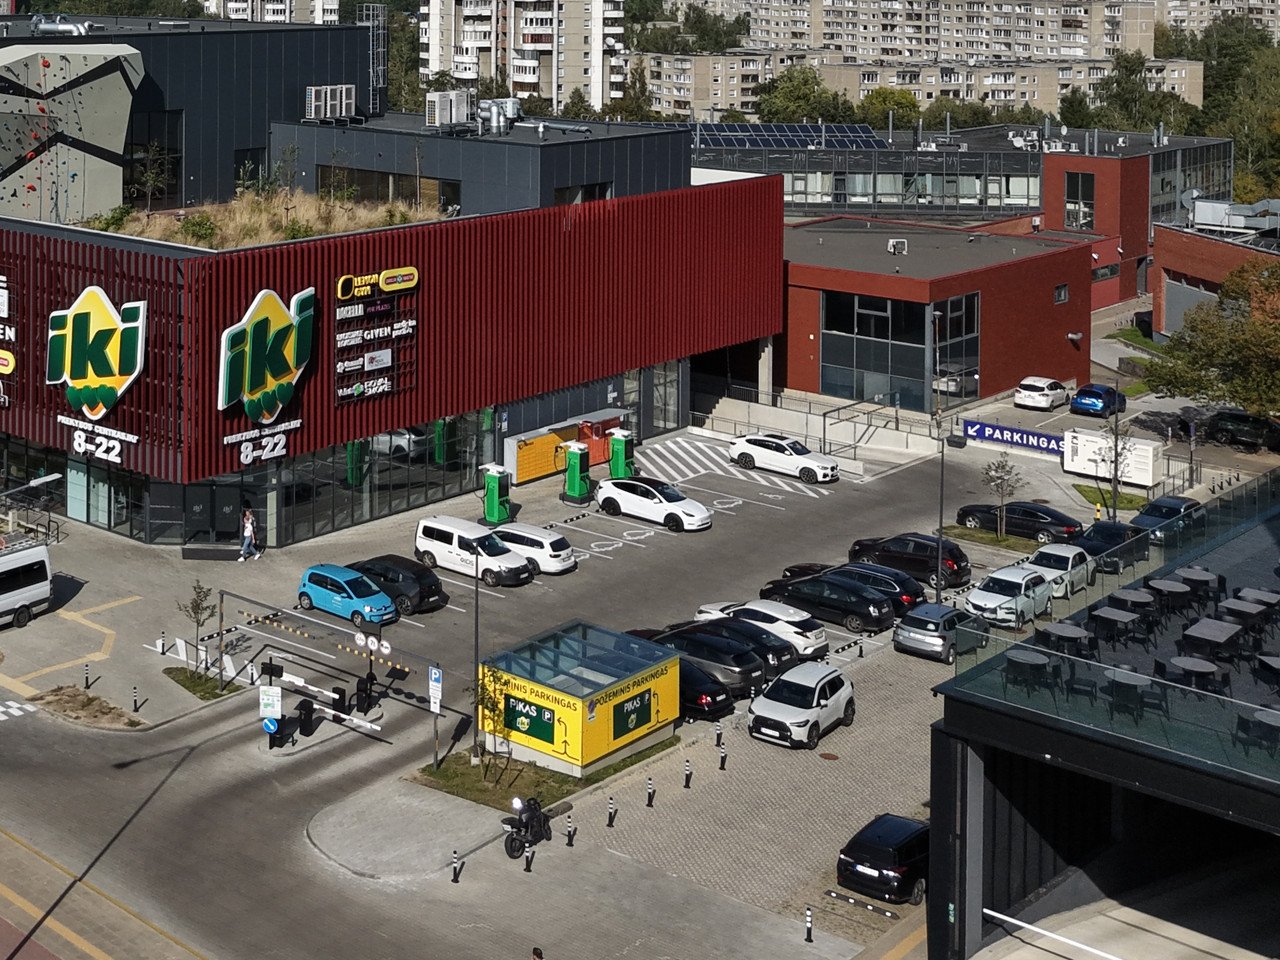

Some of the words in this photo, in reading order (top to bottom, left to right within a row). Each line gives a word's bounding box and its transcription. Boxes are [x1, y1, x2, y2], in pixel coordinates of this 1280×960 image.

[47, 306, 141, 382] iki
[364, 326, 391, 340] GIVEN
[225, 293, 315, 406] iki
[985, 427, 1065, 451] PARKINGAS
[432, 668, 440, 681] P
[594, 683, 631, 708] POŽEMINIS
[632, 665, 669, 690] PARKINGAS
[510, 698, 537, 717] PIKAS
[529, 687, 578, 712] PARKINGAS
[624, 696, 641, 713] PIKAS
